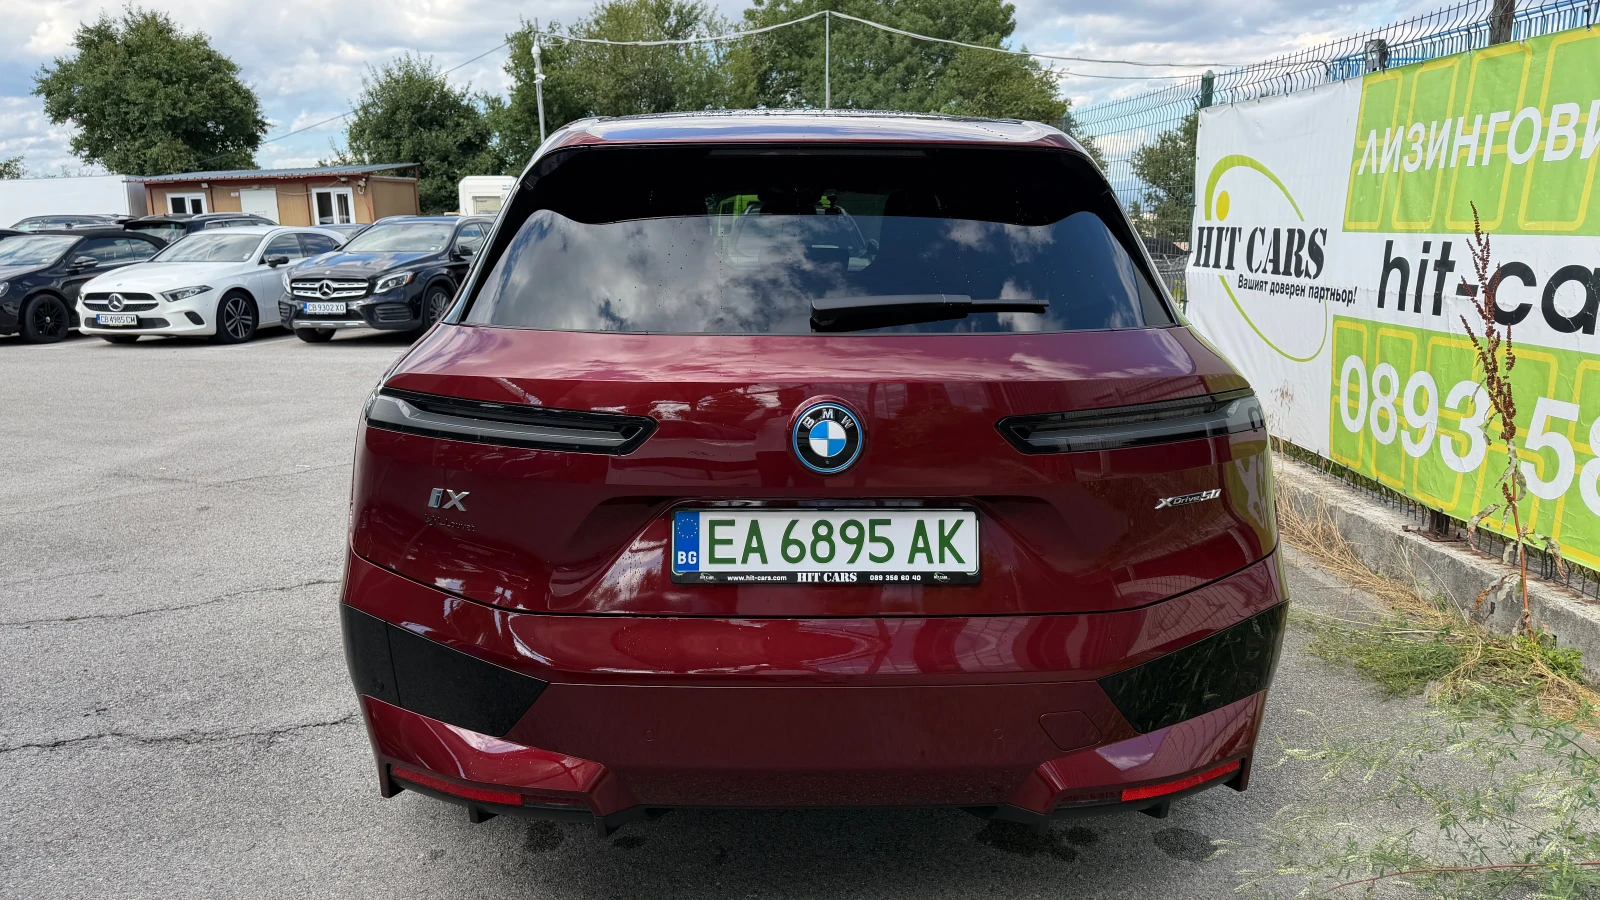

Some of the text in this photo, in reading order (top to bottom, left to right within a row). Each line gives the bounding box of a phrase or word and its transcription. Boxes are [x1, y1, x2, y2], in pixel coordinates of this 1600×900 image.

[1193, 226, 1328, 280] HIT CARS
[1237, 273, 1358, 307] Вашият доверен партньор!
[802, 408, 855, 430] BMW
[1340, 354, 1488, 473] 0893
[708, 518, 966, 565] EA 6895 AK
[677, 551, 698, 565] BG
[727, 574, 788, 582] www.hit-cars.com
[797, 572, 858, 583] HIT CARS
